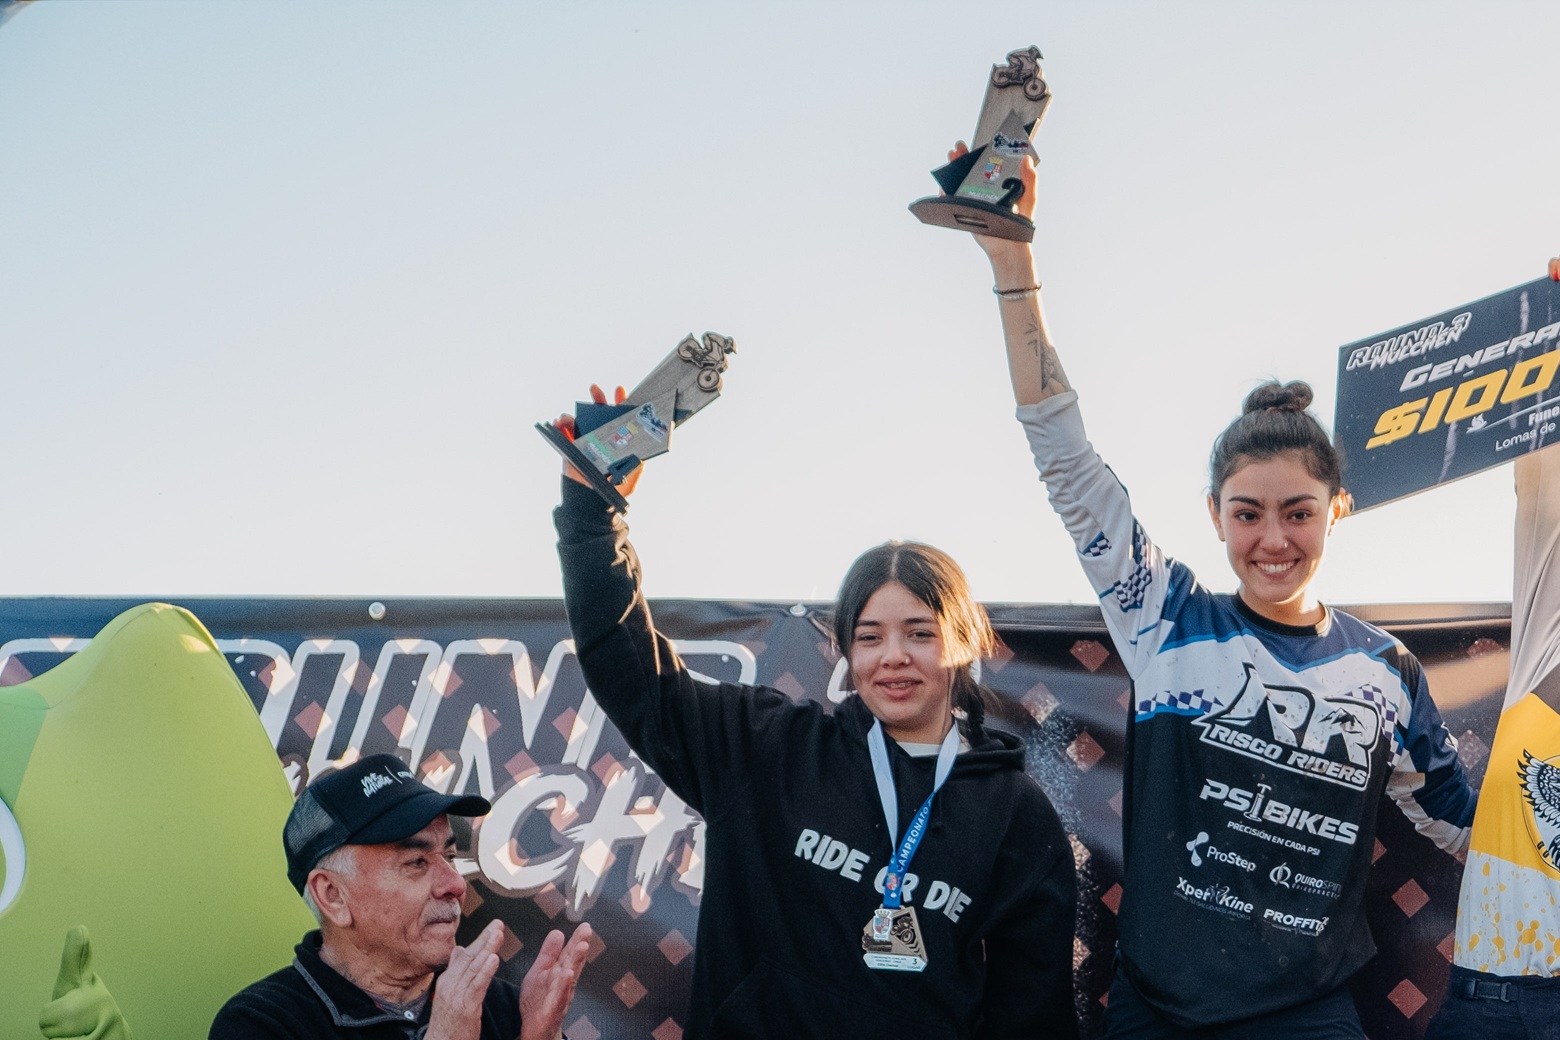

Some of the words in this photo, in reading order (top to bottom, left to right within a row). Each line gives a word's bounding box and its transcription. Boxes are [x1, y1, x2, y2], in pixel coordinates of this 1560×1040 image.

[1495, 428, 1537, 452] Lomas
[1540, 421, 1556, 434] de
[1210, 724, 1283, 762] RISCO
[1287, 750, 1370, 786] RIDERS
[1206, 846, 1257, 872] ProStep
[1272, 837, 1285, 846] EN
[1284, 840, 1307, 852] CADA
[1306, 847, 1321, 857] PSI
[794, 829, 871, 883] RIDE
[923, 880, 972, 924] DIE
